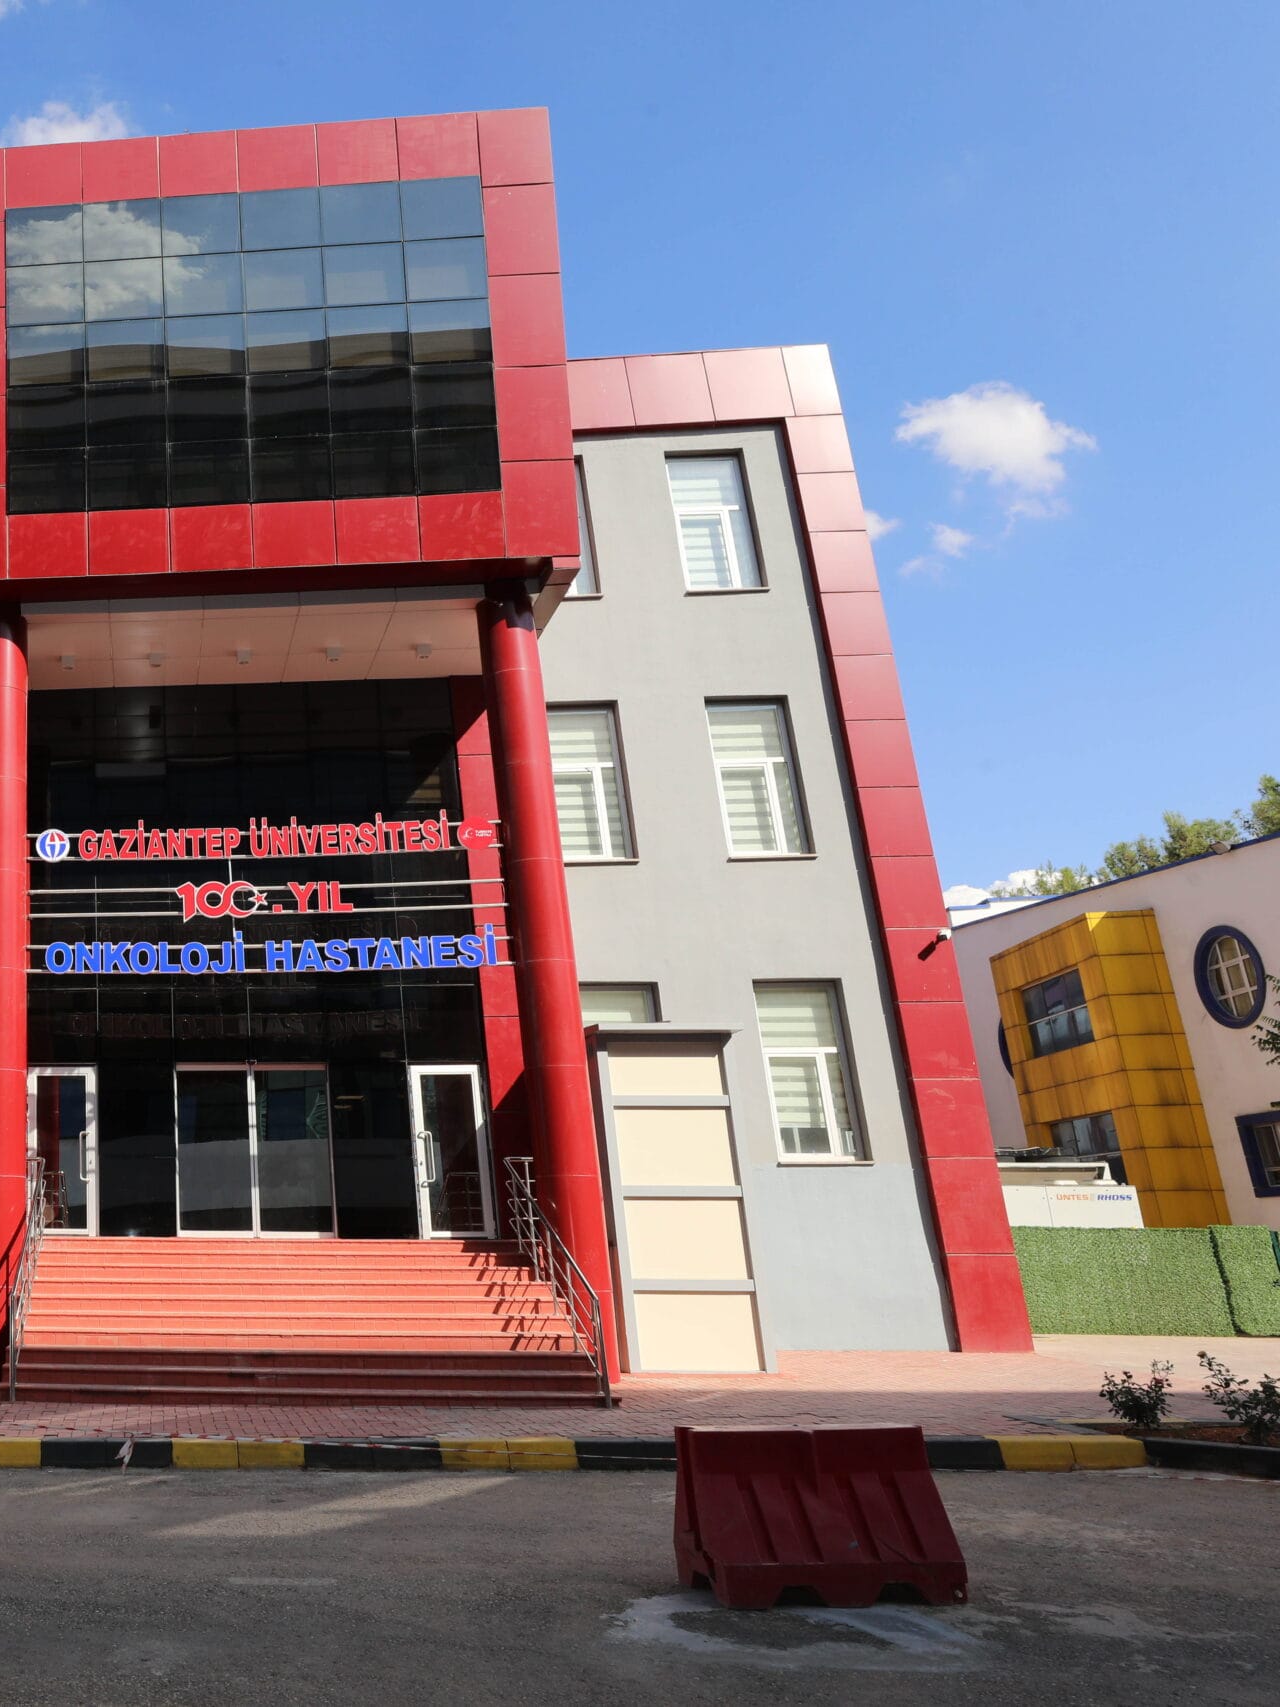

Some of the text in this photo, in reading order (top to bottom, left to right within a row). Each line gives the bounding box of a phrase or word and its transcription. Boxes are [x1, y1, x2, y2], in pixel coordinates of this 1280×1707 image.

[78, 808, 451, 861] GAZİANTEP ÜNİVERSİTESİ
[287, 880, 354, 913] YIL
[45, 923, 499, 974] ONKOLOJİ HASTANESİ
[1097, 1193, 1133, 1201] RHOSS
